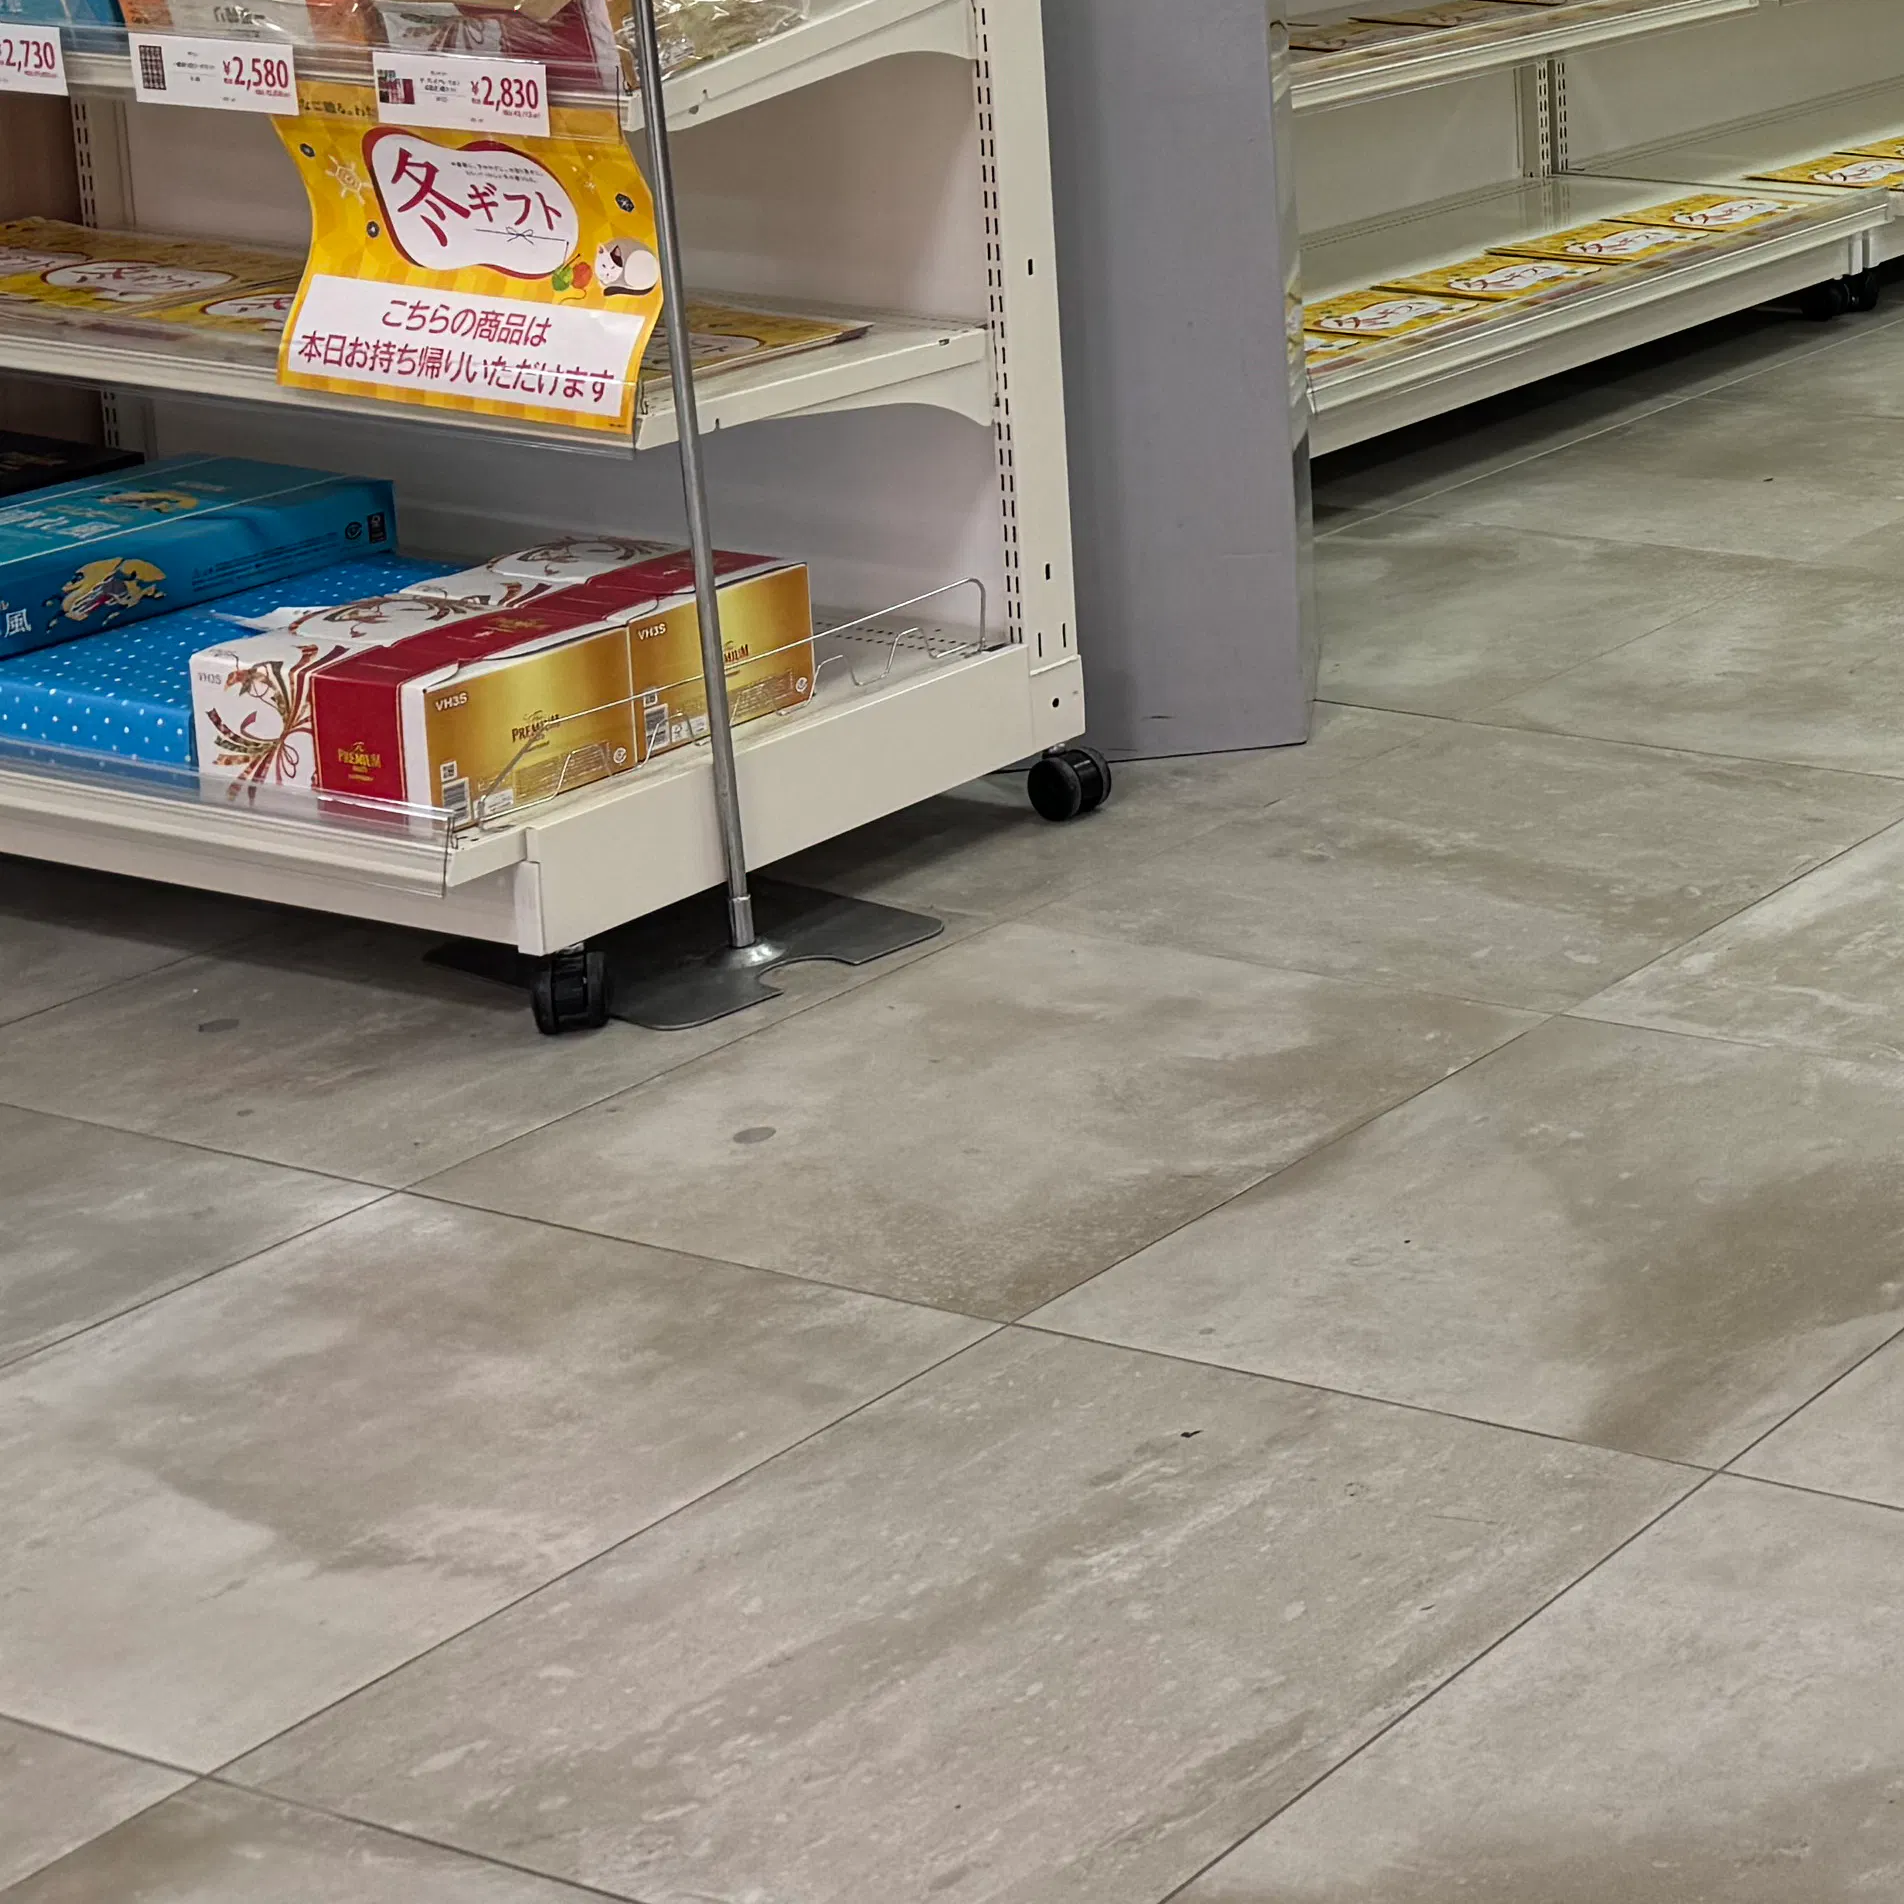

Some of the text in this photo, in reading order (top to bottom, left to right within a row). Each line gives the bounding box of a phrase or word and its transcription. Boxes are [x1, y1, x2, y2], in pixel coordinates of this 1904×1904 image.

[391, 147, 562, 248] 冬ギフト
[381, 297, 552, 348] こちらの商品は
[298, 329, 616, 403] 本日お持ち帰りいただけます
[637, 622, 667, 641] VH3S
[434, 692, 468, 711] VH3S
